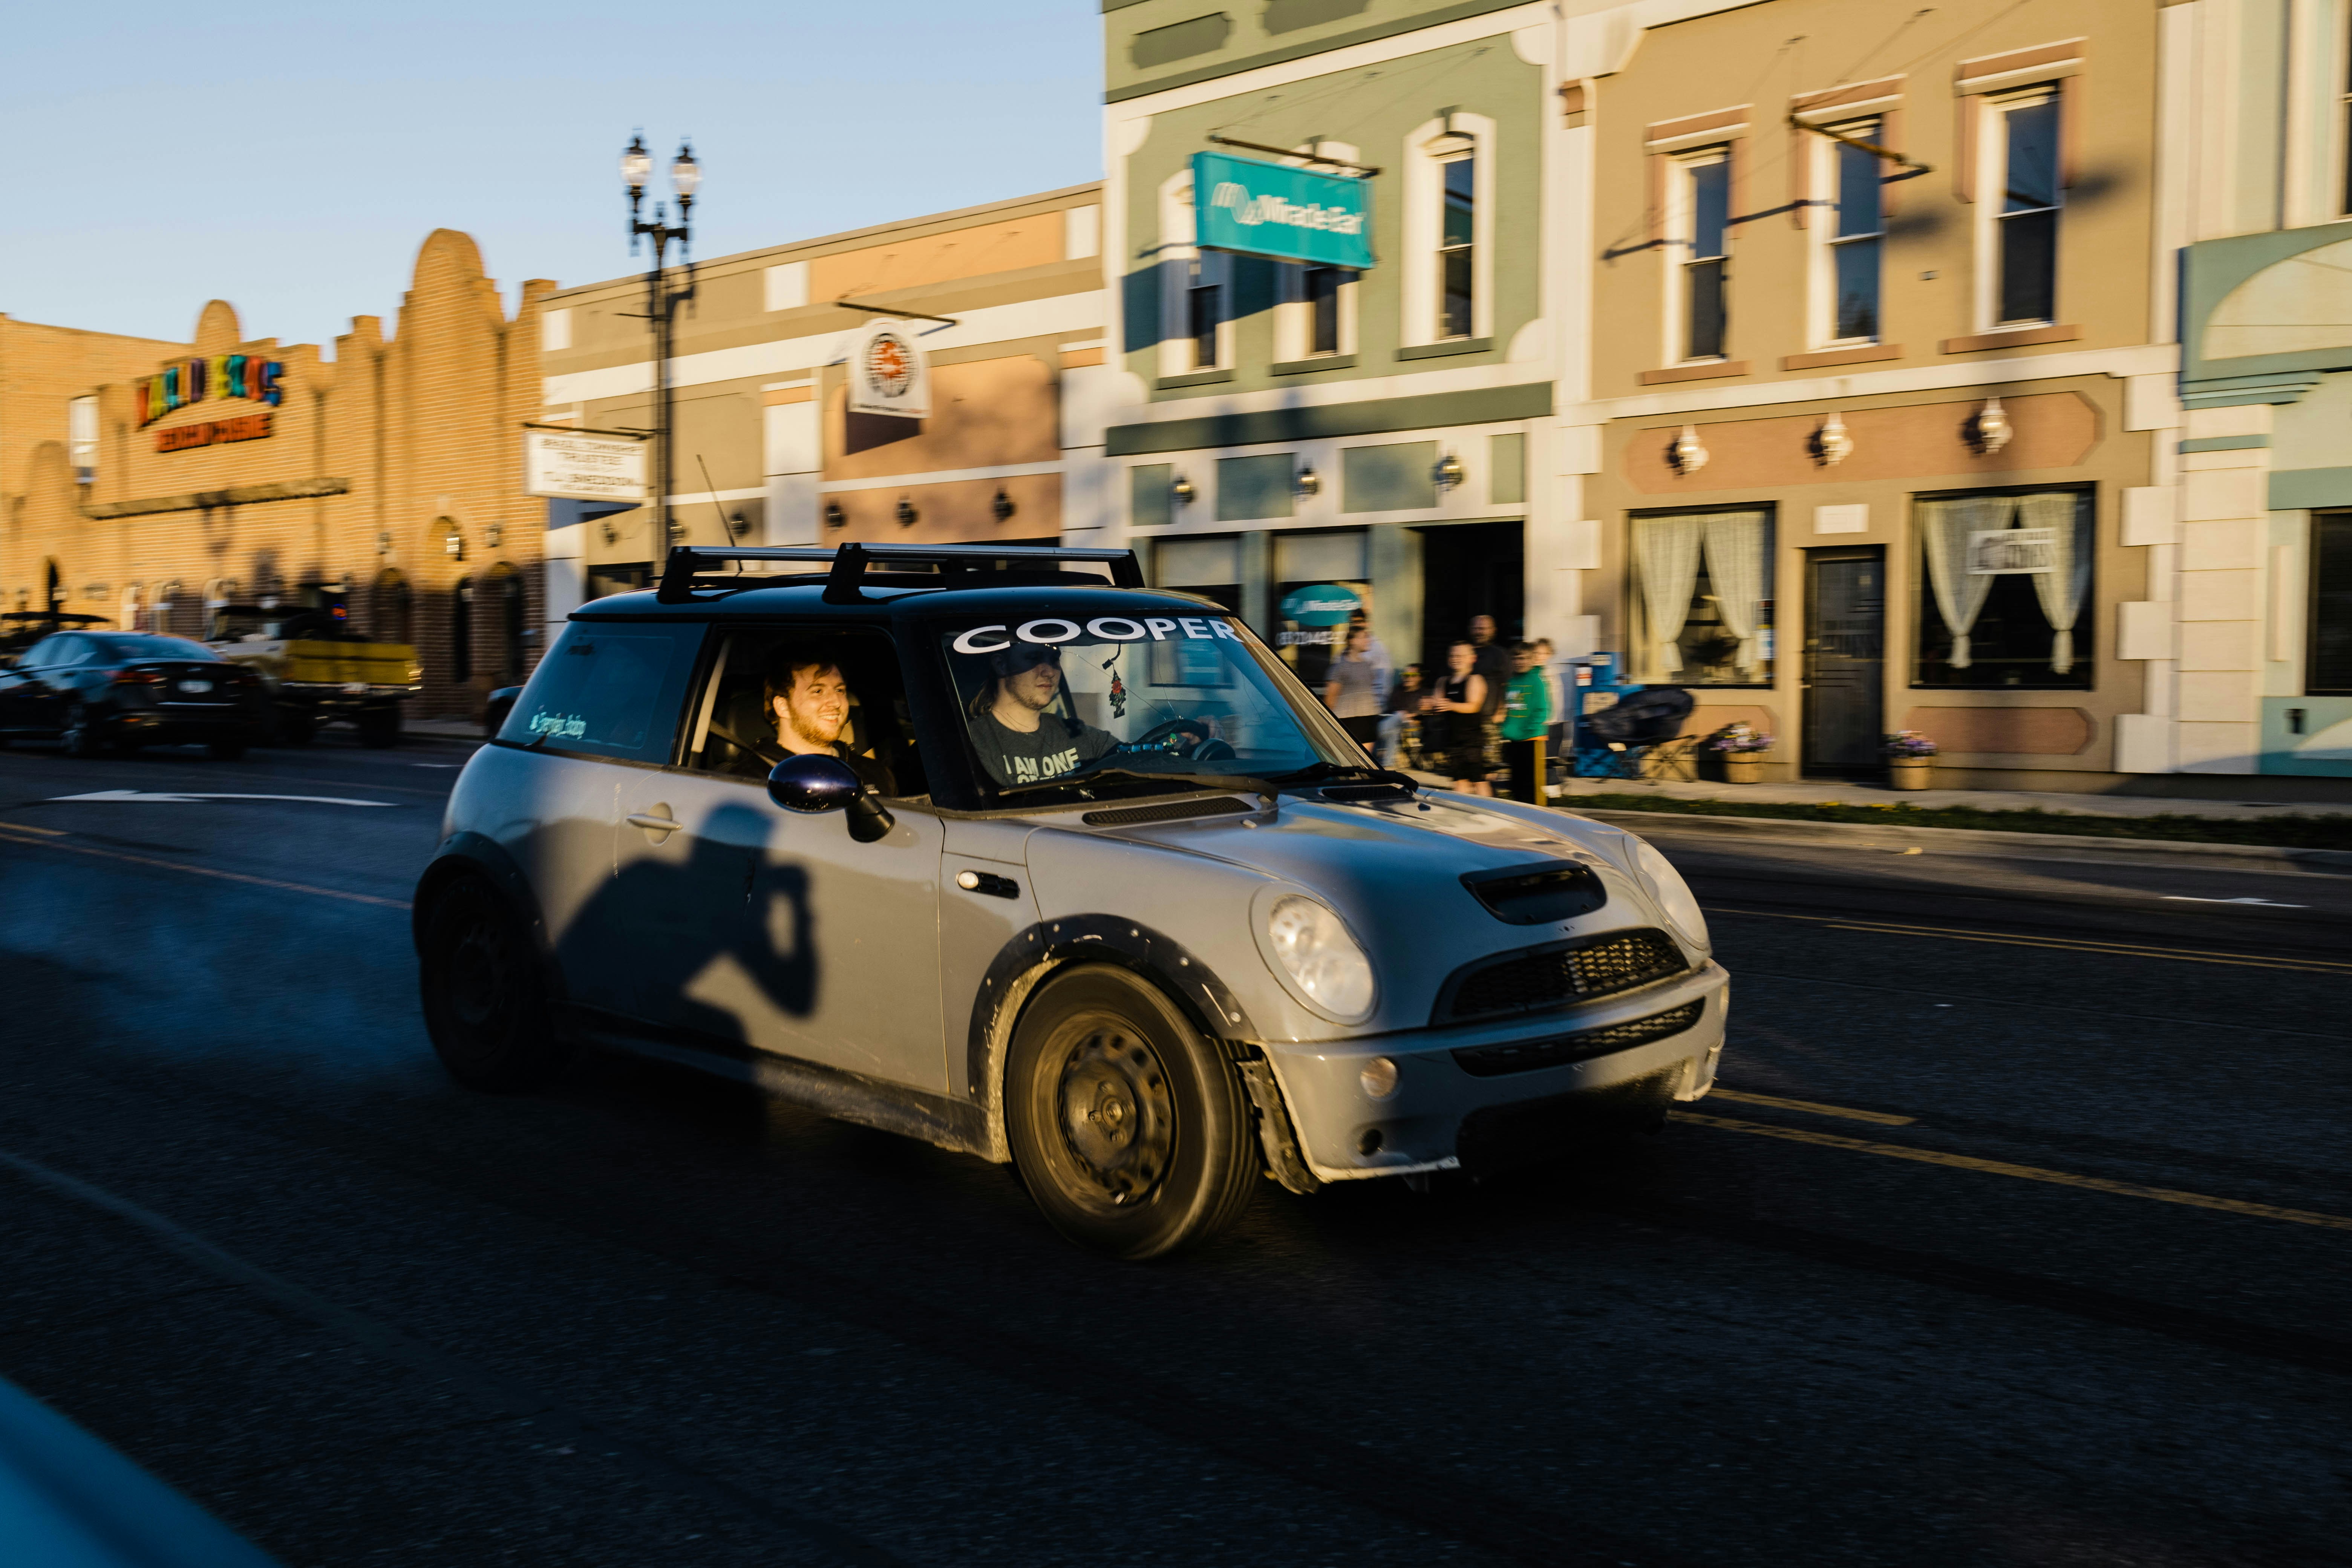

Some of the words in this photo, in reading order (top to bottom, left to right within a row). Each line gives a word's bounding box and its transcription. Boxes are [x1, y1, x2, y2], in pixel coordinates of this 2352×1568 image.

[952, 617, 1244, 654] COOPER
[1003, 754, 1012, 775] I
[1014, 756, 1040, 778] AM
[1042, 747, 1081, 776] ONE
